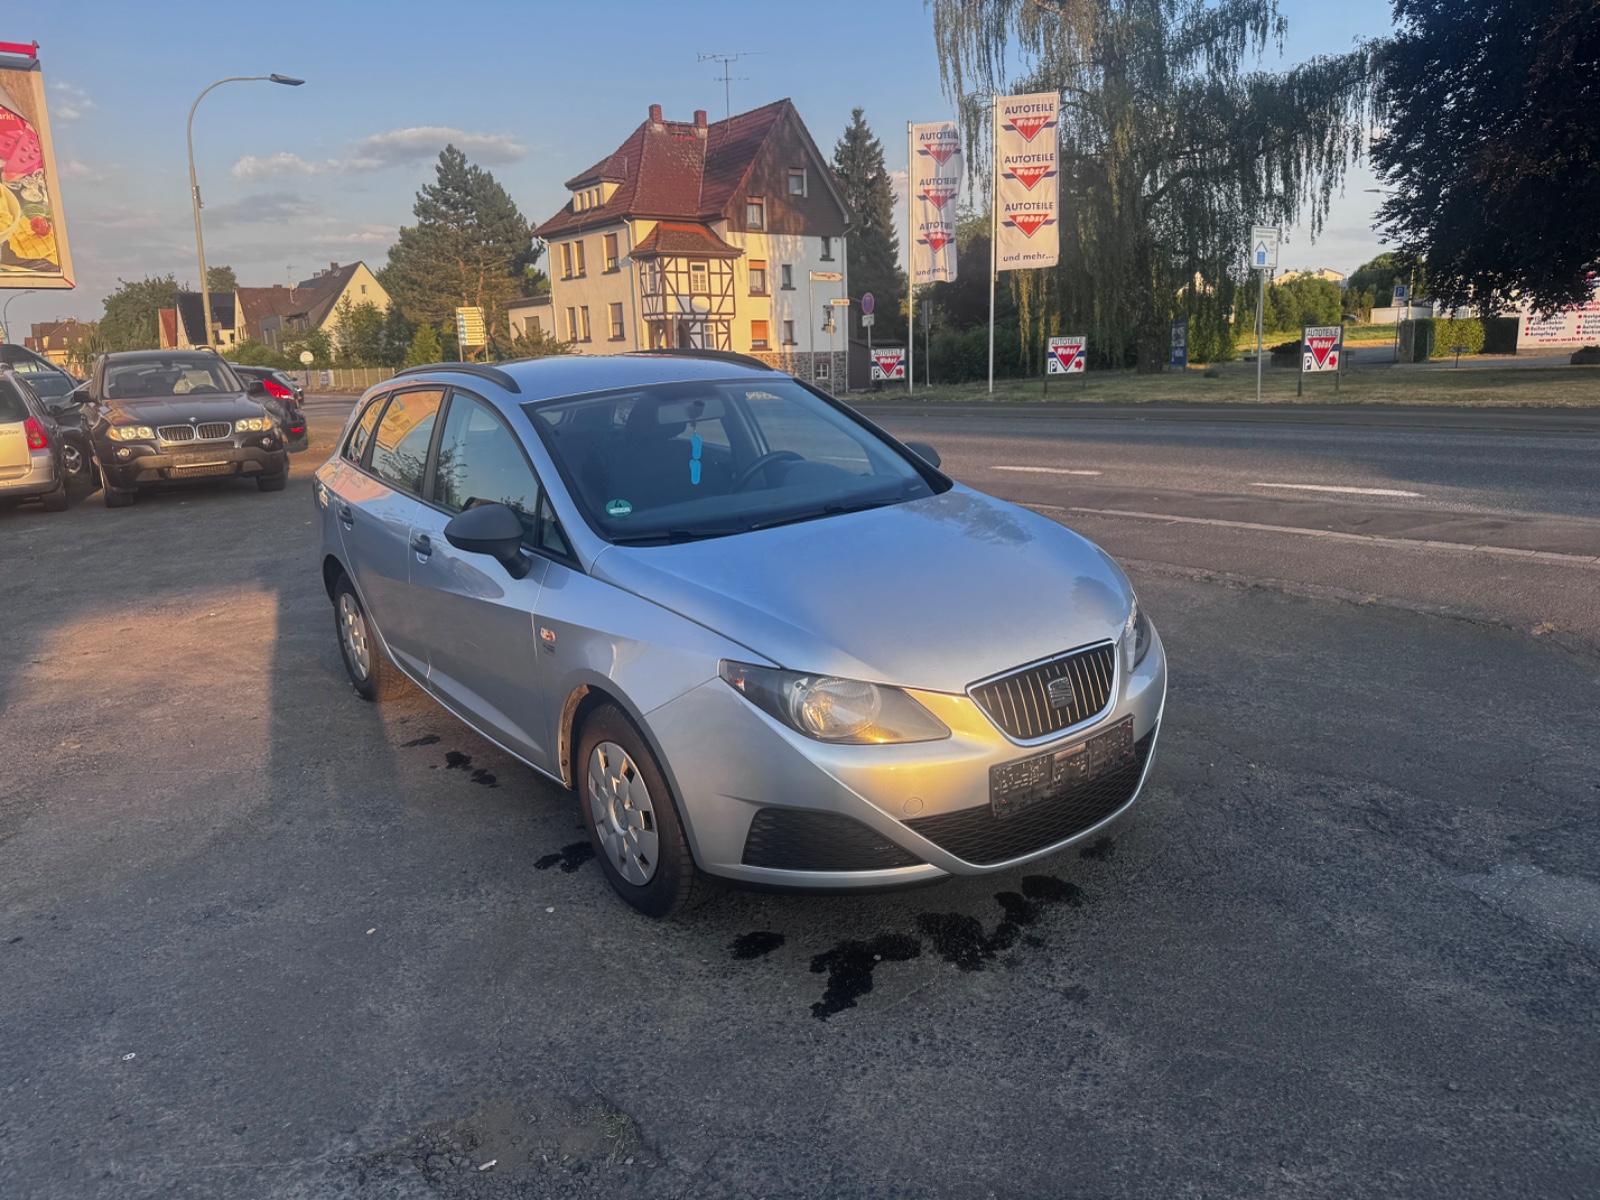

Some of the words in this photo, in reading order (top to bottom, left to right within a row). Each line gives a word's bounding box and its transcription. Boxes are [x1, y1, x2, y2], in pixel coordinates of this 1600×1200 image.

[1005, 103, 1054, 115] AUTOTEILE
[1005, 153, 1054, 164] AUTOTEILE
[1005, 202, 1054, 212] AUTOTEILE
[1003, 253, 1020, 262] und
